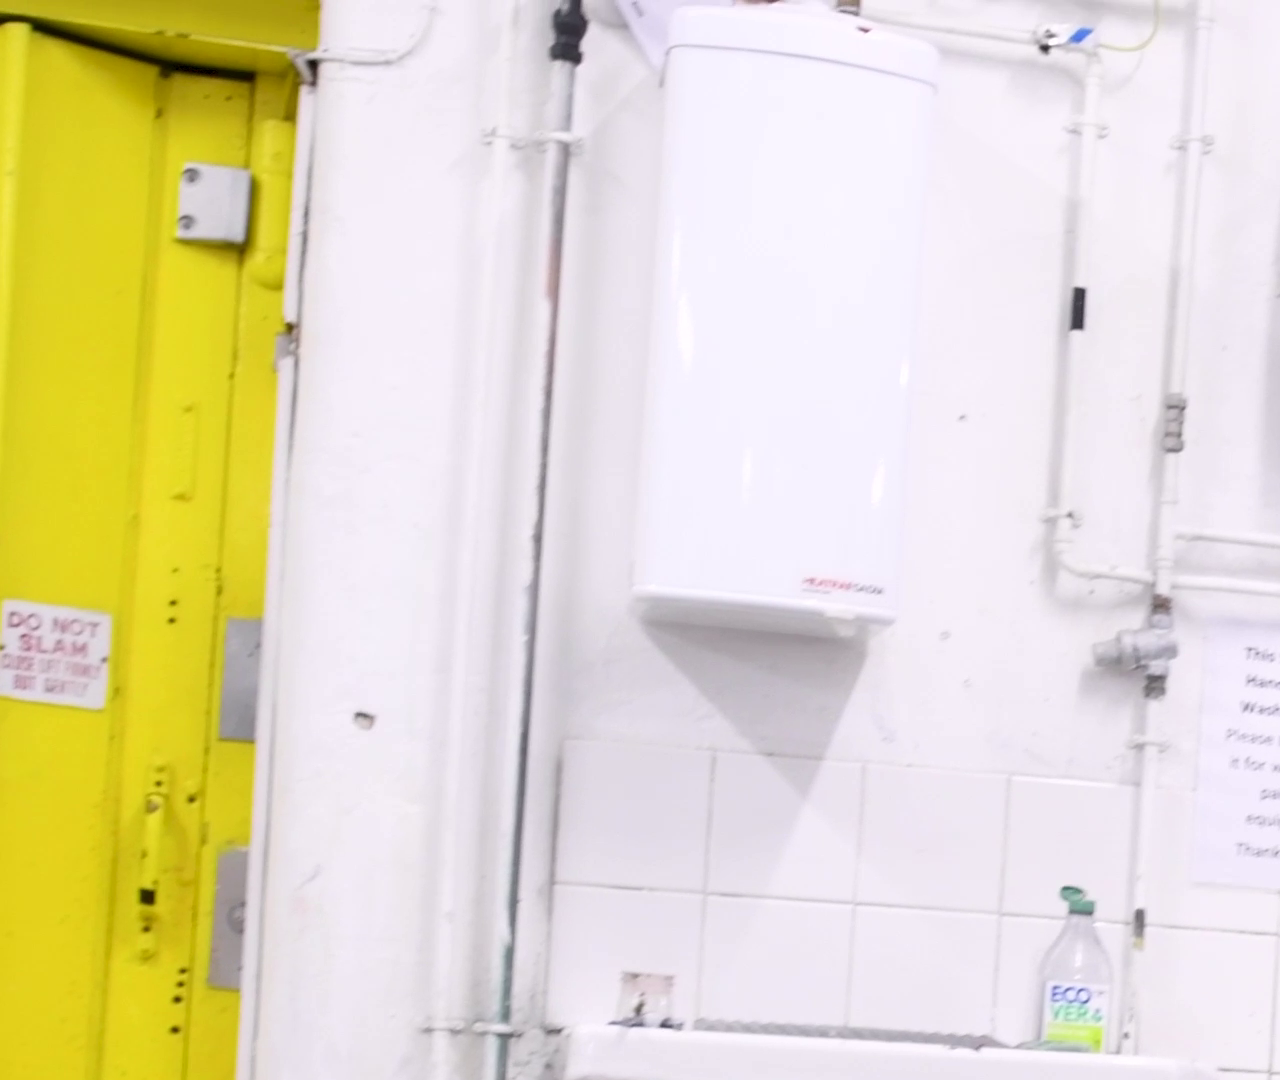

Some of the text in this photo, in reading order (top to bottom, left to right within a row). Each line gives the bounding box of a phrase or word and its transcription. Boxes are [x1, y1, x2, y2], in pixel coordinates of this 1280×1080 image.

[8, 611, 100, 638] DO NOT
[20, 633, 89, 659] SLAM
[1244, 646, 1275, 662] This
[1225, 728, 1273, 745] Please
[1229, 757, 1240, 769] it
[1244, 756, 1266, 771] for
[1236, 842, 1280, 859] Thank
[1051, 985, 1092, 1004] ECO
